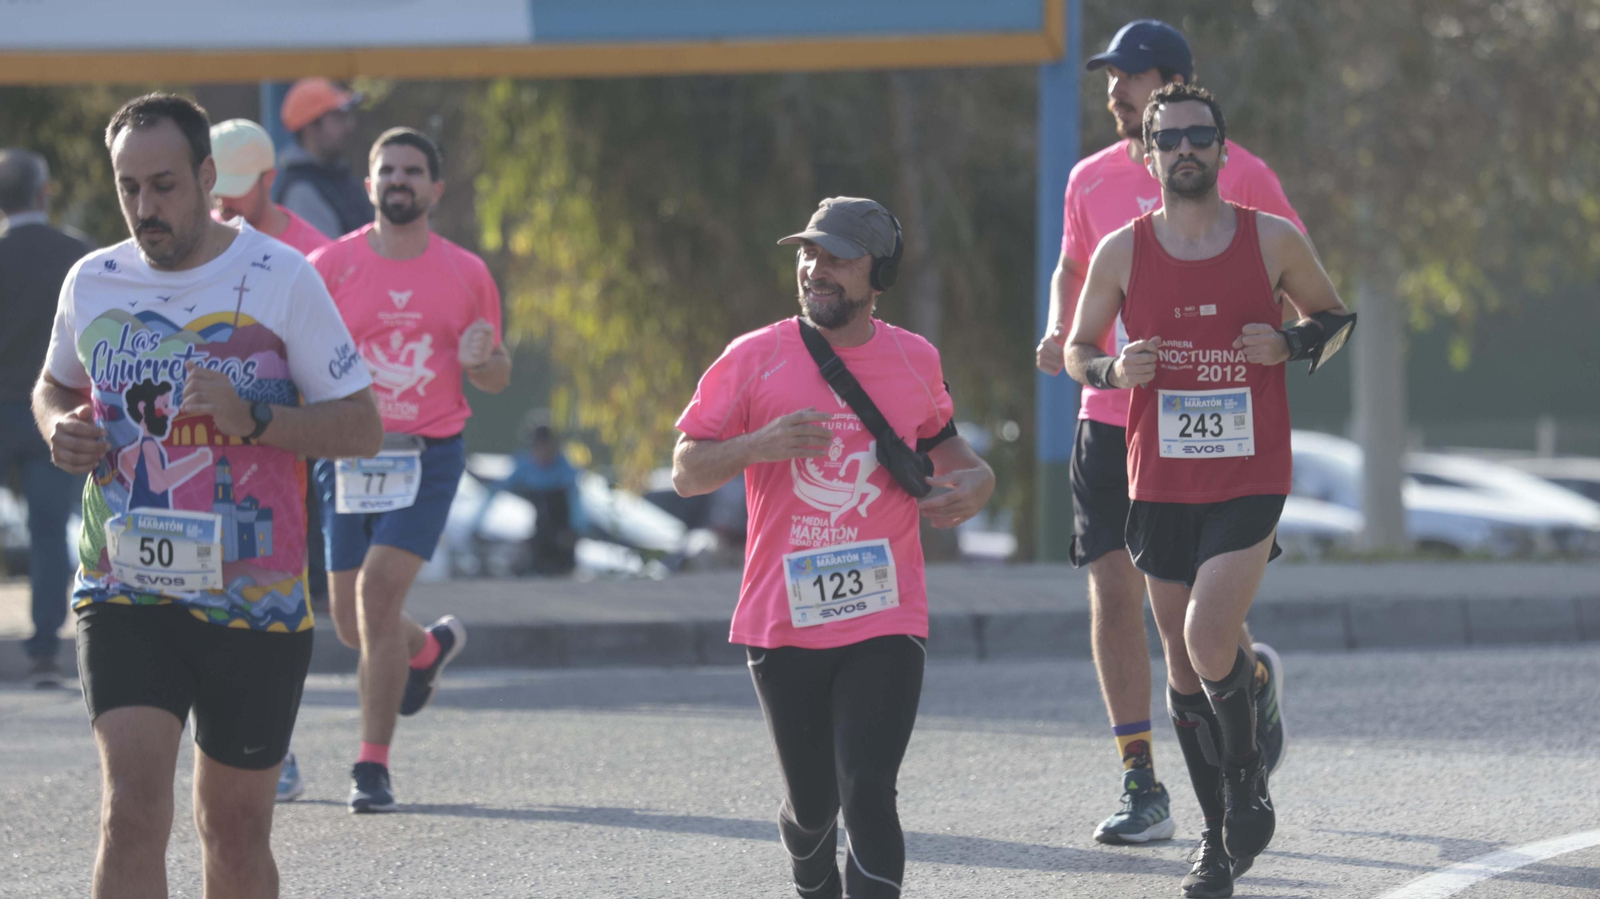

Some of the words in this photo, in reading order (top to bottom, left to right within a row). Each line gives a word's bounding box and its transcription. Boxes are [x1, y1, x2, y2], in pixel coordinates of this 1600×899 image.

[1158, 349, 1247, 364] NOCTURNA
[1197, 364, 1247, 382] 2012
[1184, 397, 1222, 408] MARATÓN
[1178, 412, 1223, 438] 243
[1182, 445, 1225, 454] EVOS
[363, 472, 387, 494] 77
[138, 517, 184, 532] MARATÓN
[801, 515, 829, 527] MEDIA
[790, 524, 858, 542] MARATÓN
[812, 540, 822, 548] DE
[140, 537, 174, 567] 50
[816, 552, 859, 567] MARATÓN
[134, 574, 186, 586] EVOS
[812, 569, 864, 602] 123
[819, 601, 867, 618] EVOS
